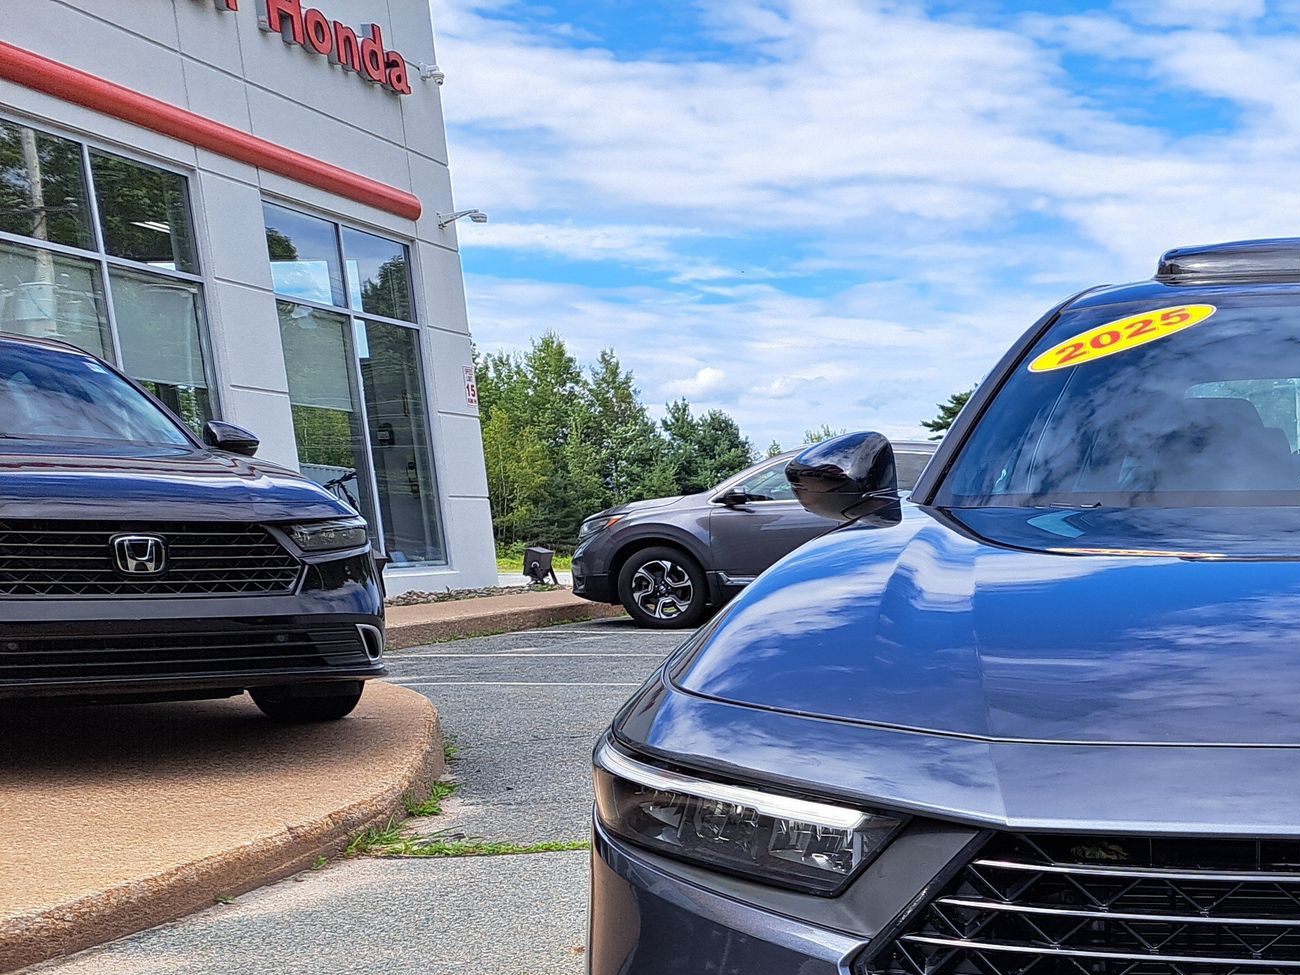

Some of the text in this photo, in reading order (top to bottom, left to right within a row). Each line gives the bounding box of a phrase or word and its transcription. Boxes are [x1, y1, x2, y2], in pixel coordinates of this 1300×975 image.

[264, 0, 412, 95] Honda
[1055, 307, 1193, 366] 2025
[466, 383, 476, 397] 15
